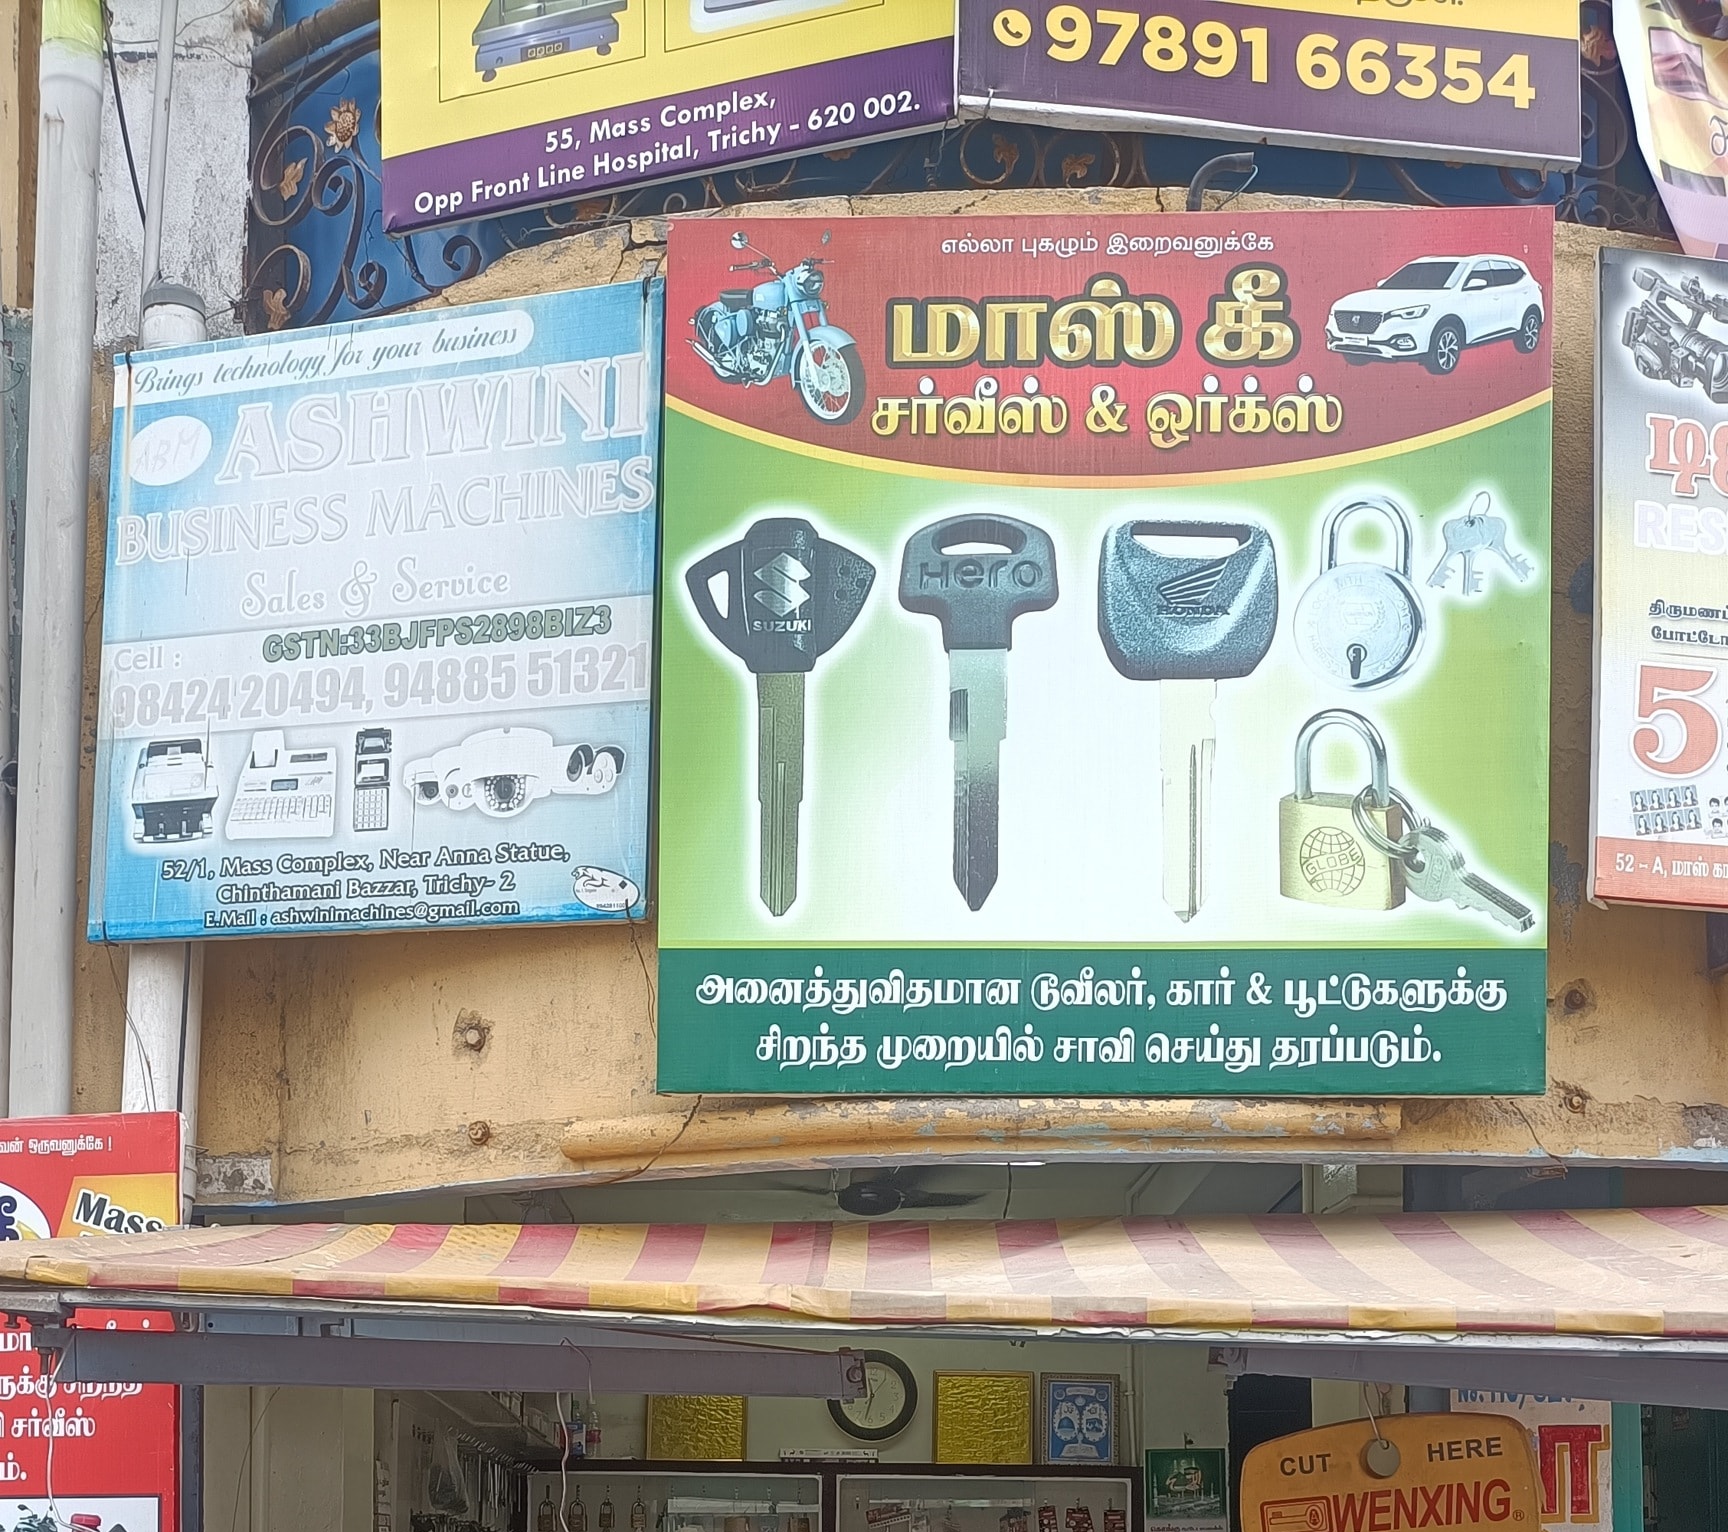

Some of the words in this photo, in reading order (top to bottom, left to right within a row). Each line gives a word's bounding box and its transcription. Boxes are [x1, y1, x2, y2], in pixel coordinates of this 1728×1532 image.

[1045, 6, 1268, 84] 97891
[1296, 33, 1536, 110] 66354
[545, 129, 580, 154] 55,
[588, 116, 652, 144] Mass
[660, 91, 777, 128] Complex,
[413, 187, 464, 216] Opp
[470, 172, 531, 204] Front
[537, 163, 585, 190] Line
[593, 140, 700, 177] Hospital,
[707, 123, 782, 155] Trichy
[807, 105, 856, 132] 620
[864, 89, 921, 119] 002.
[940, 232, 1014, 254] எல்லா
[1020, 231, 1099, 259] புகழும்
[1105, 231, 1275, 258] இறைவனுக்கே
[889, 275, 1179, 364] மாஸ்
[1202, 265, 1296, 364] கீ
[134, 366, 205, 396] Brings
[212, 351, 325, 385] technology
[333, 343, 364, 377] for
[368, 339, 422, 372] your
[432, 325, 519, 356] business
[214, 352, 649, 485] ASHWINI
[870, 374, 1068, 436] சர்வீஸ்
[1085, 383, 1128, 434] &
[115, 490, 350, 566] BUSINESS
[365, 455, 655, 541] MACHINES
[240, 567, 327, 619] Sales
[339, 558, 378, 618] &
[391, 555, 511, 604] Service
[919, 559, 1043, 590] Hero
[752, 618, 812, 633] SUZUKI
[113, 646, 165, 673] Cell
[112, 675, 233, 729] 98424
[240, 666, 375, 720] 20494,
[383, 654, 516, 707] 94885
[527, 642, 650, 697] 51321
[161, 856, 217, 882] 52/1,
[220, 854, 273, 877] Mass
[276, 848, 375, 876] Complex,
[380, 846, 431, 869] Near
[434, 845, 492, 867] Anna
[496, 841, 571, 866] Statue,
[1305, 850, 1361, 876] GLOBE
[1615, 853, 1635, 872] 52
[216, 879, 342, 905] Chinthamani
[347, 876, 418, 901] Bazzar,
[270, 899, 520, 926] ashwinimachines@gmail.com
[696, 966, 1021, 1015] அனைத்துவிதமான
[1166, 966, 1235, 1006] கார்
[1246, 972, 1273, 1006] &
[1284, 966, 1508, 1018] பூட்டுகளுக்கு
[756, 1023, 868, 1071] சிறந்த
[876, 1024, 1044, 1071] முறையில்
[1053, 1027, 1135, 1064] சாவி
[1145, 1023, 1261, 1073] செய்து
[1269, 1023, 1442, 1071] தரப்படும்.
[76, 1190, 164, 1236] Mass
[1280, 1453, 1332, 1476] CUT
[1427, 1437, 1503, 1463] HERE
